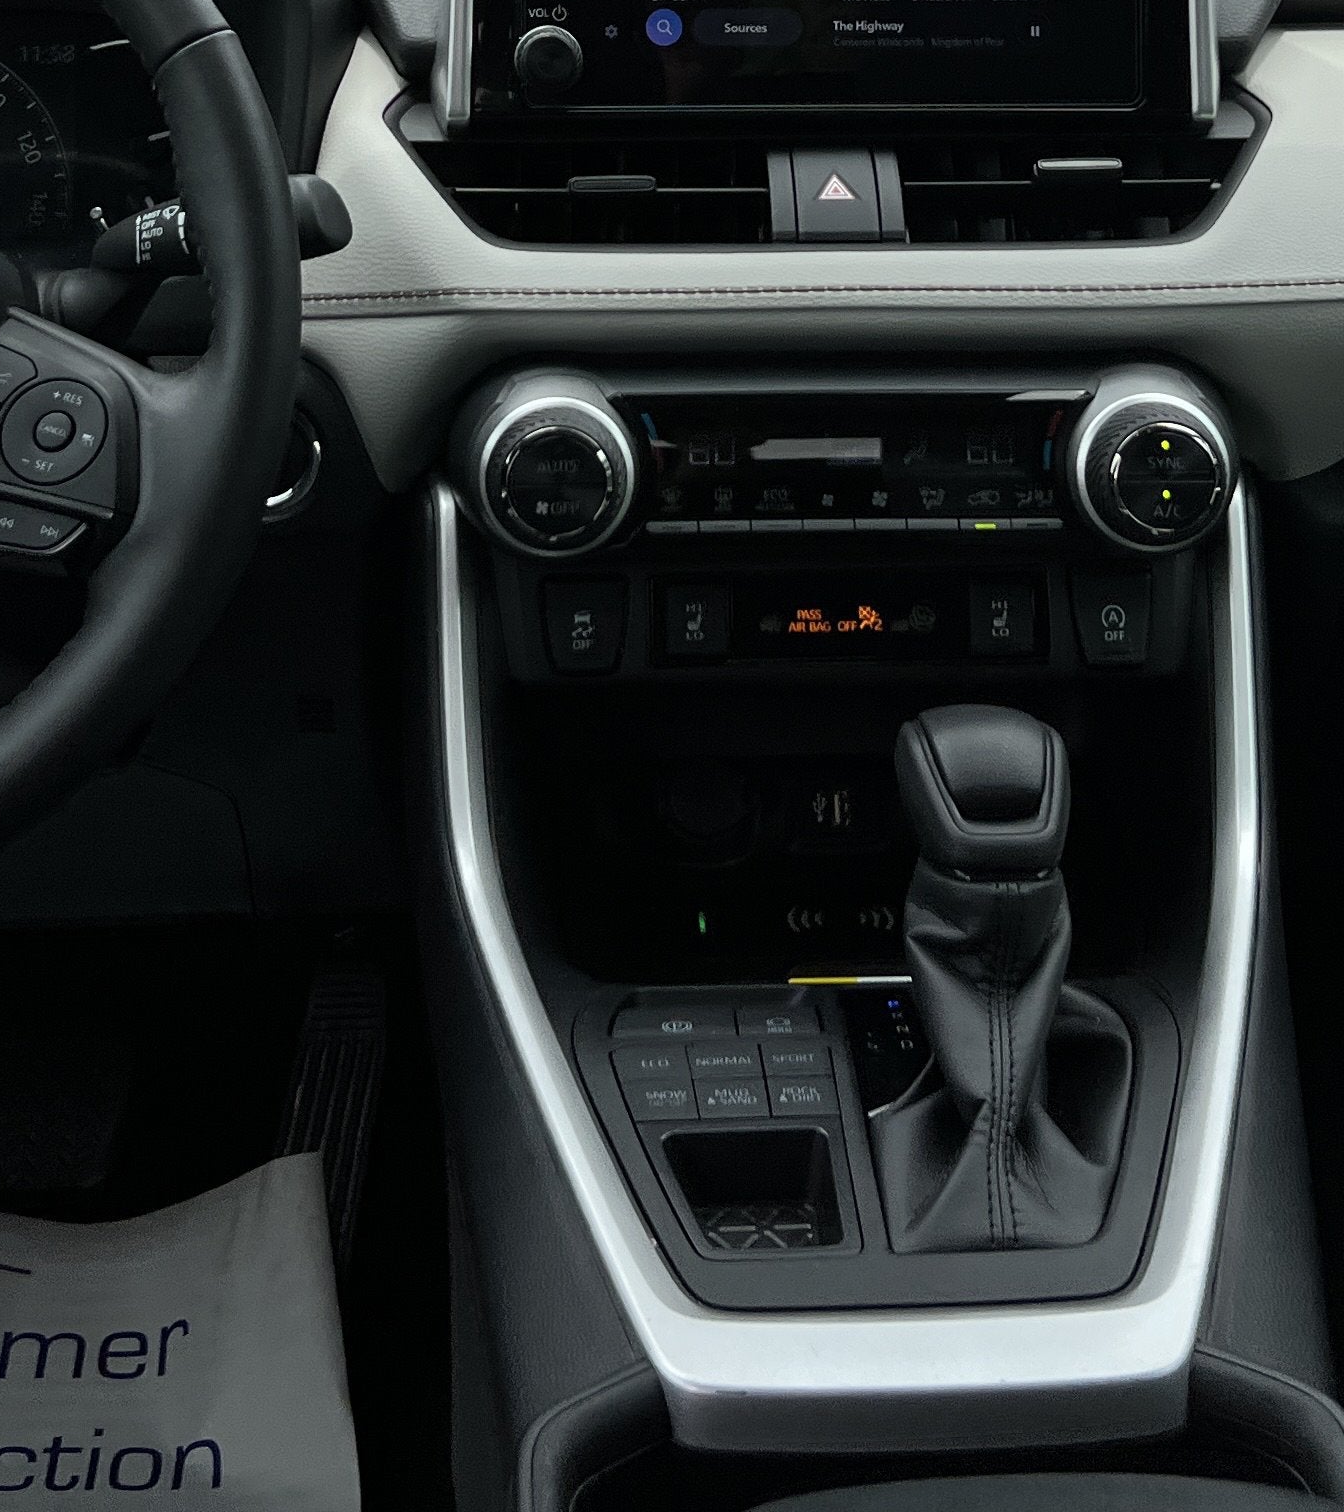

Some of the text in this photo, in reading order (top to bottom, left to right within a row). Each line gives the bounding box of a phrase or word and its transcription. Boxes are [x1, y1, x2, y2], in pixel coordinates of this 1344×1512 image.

[527, 7, 550, 19] VOL
[723, 21, 768, 34] Sources
[833, 19, 905, 35] The Highway
[16, 129, 42, 165] 120
[141, 219, 156, 230] OFF
[141, 226, 164, 240] AUTO
[141, 240, 152, 251] LO
[62, 391, 84, 406] RES
[33, 459, 55, 472] SET
[1145, 455, 1184, 468] SYNC
[795, 608, 823, 621] PASS
[787, 620, 807, 633] AIR
[808, 620, 833, 633] BAG
[837, 620, 857, 633] OFF
[991, 627, 1010, 638] LO
[1104, 630, 1126, 642] OFF
[572, 638, 593, 651] OFF
